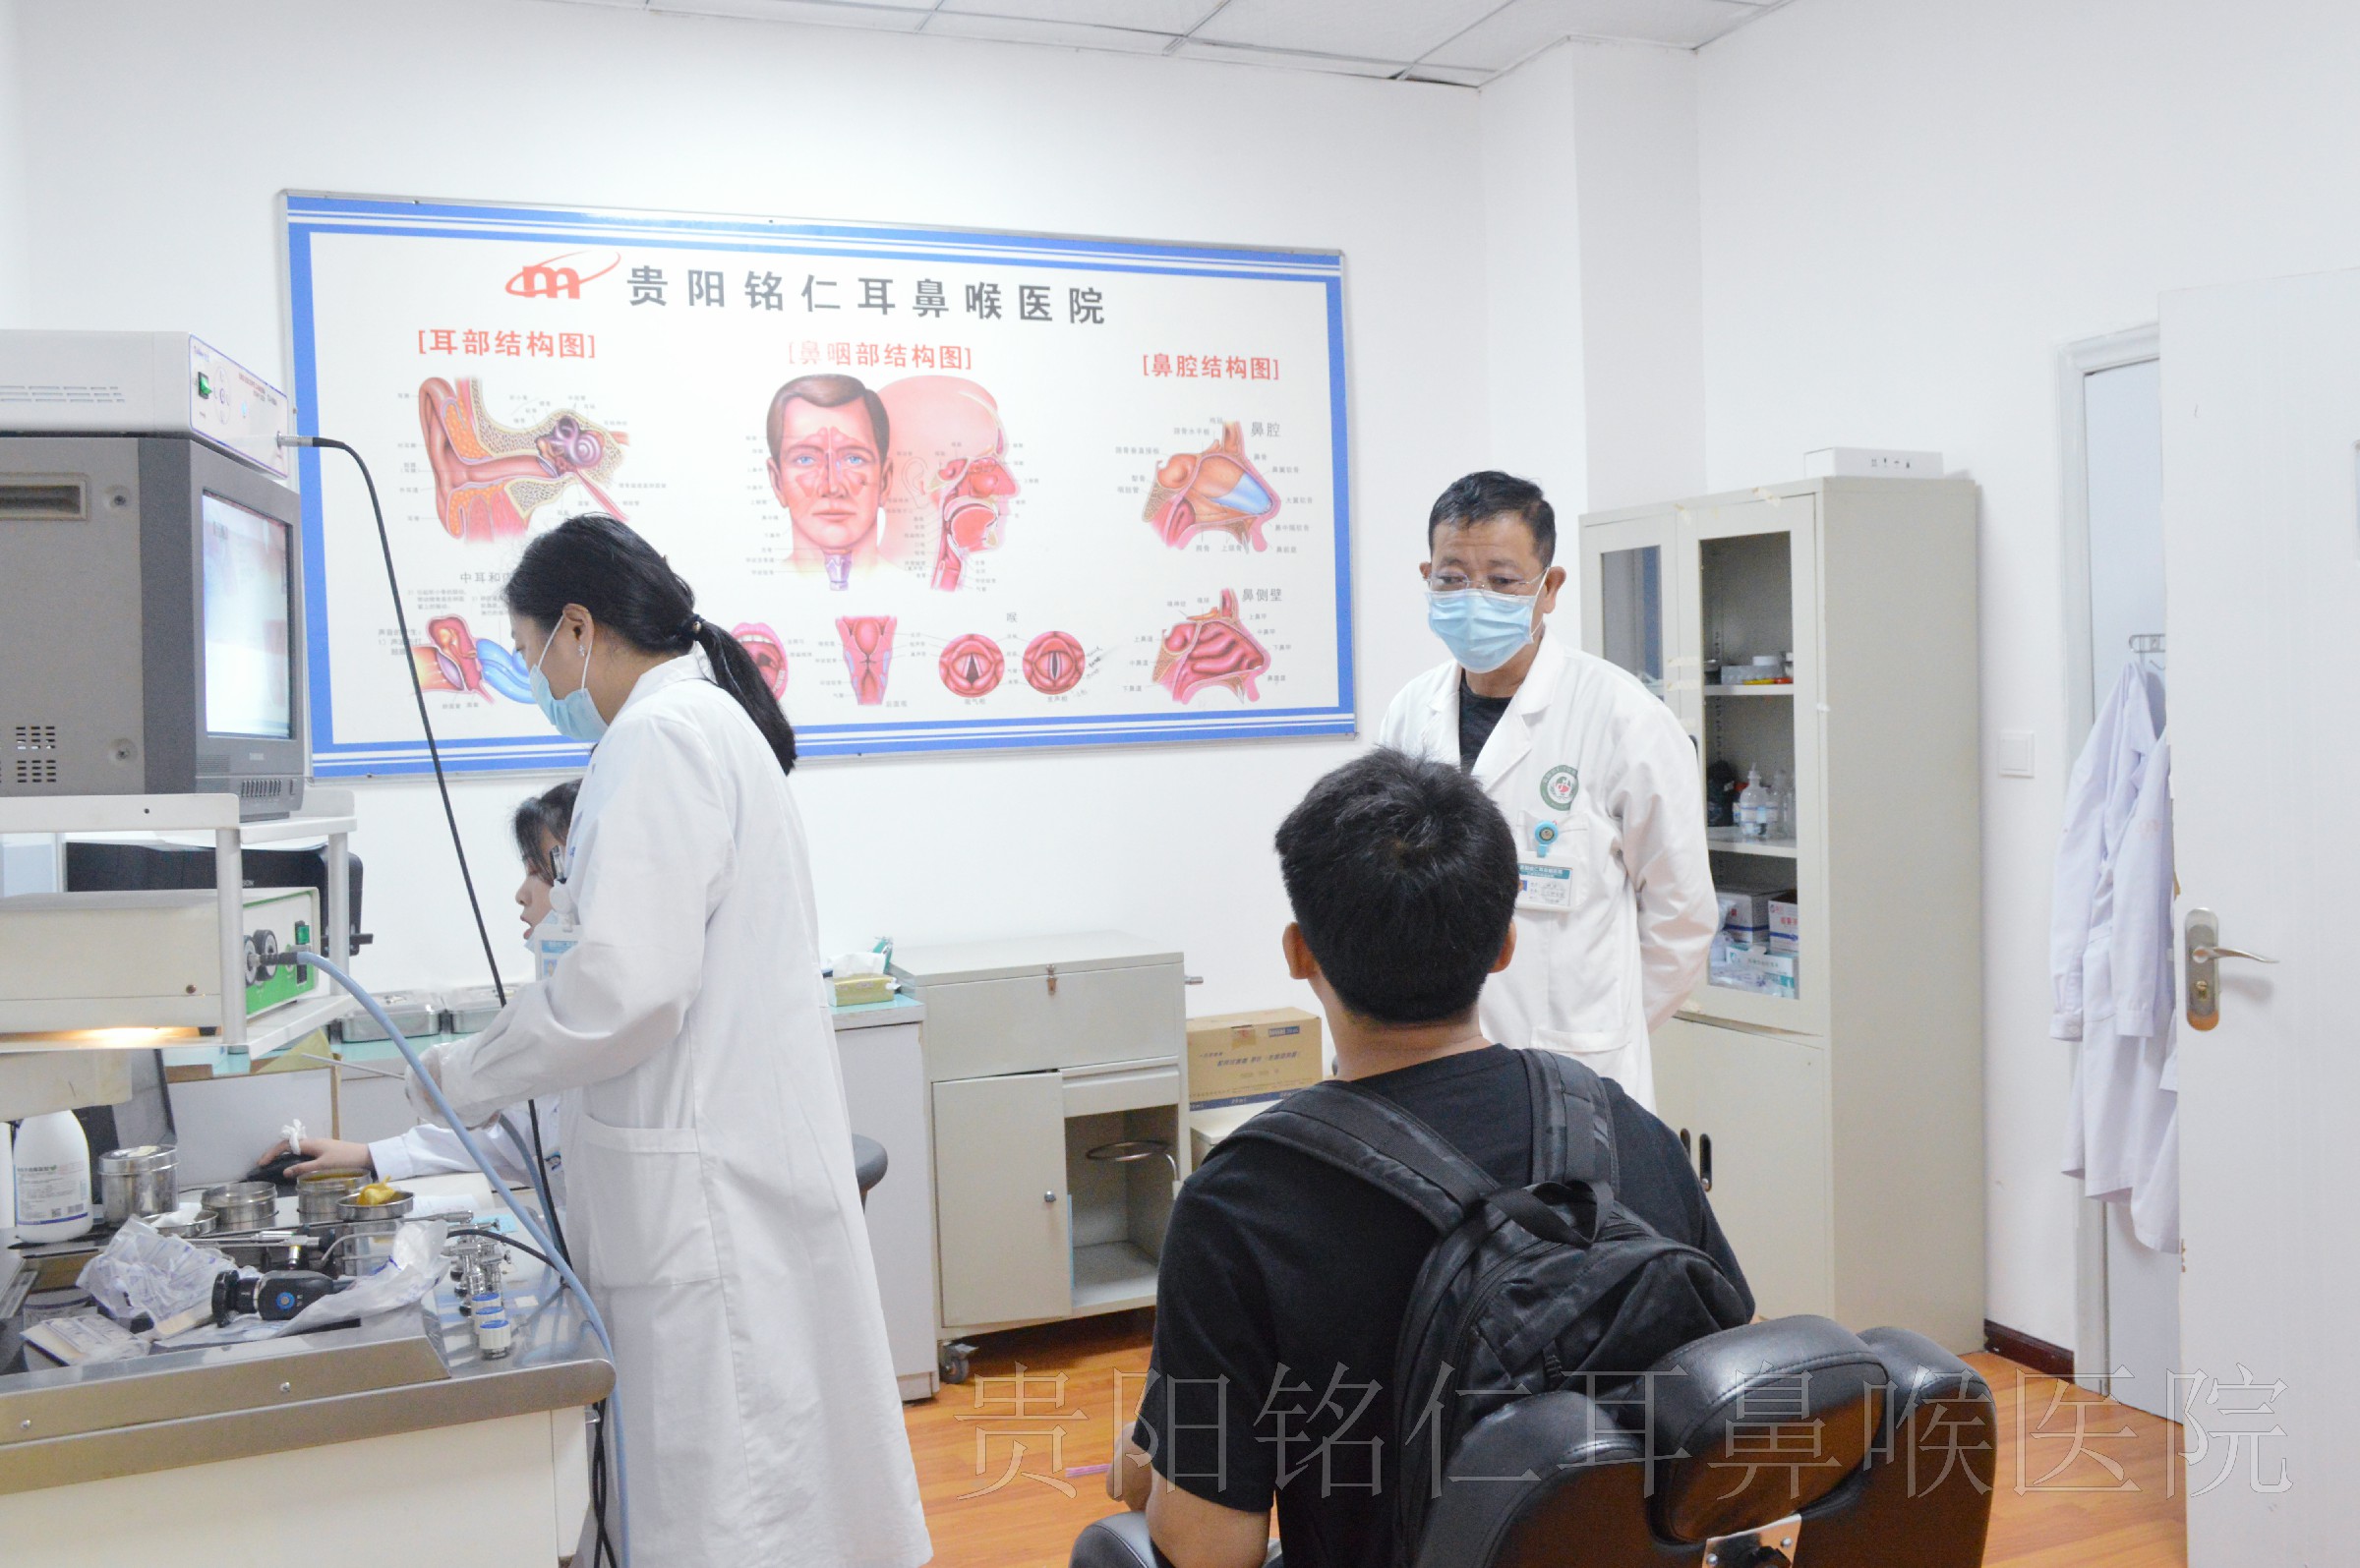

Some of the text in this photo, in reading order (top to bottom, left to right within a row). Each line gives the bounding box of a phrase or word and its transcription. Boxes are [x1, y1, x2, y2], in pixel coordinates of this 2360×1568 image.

[627, 264, 1107, 325] 贵阳铭仁耳鼻喉医院
[1251, 422, 1281, 437] 鼻腔
